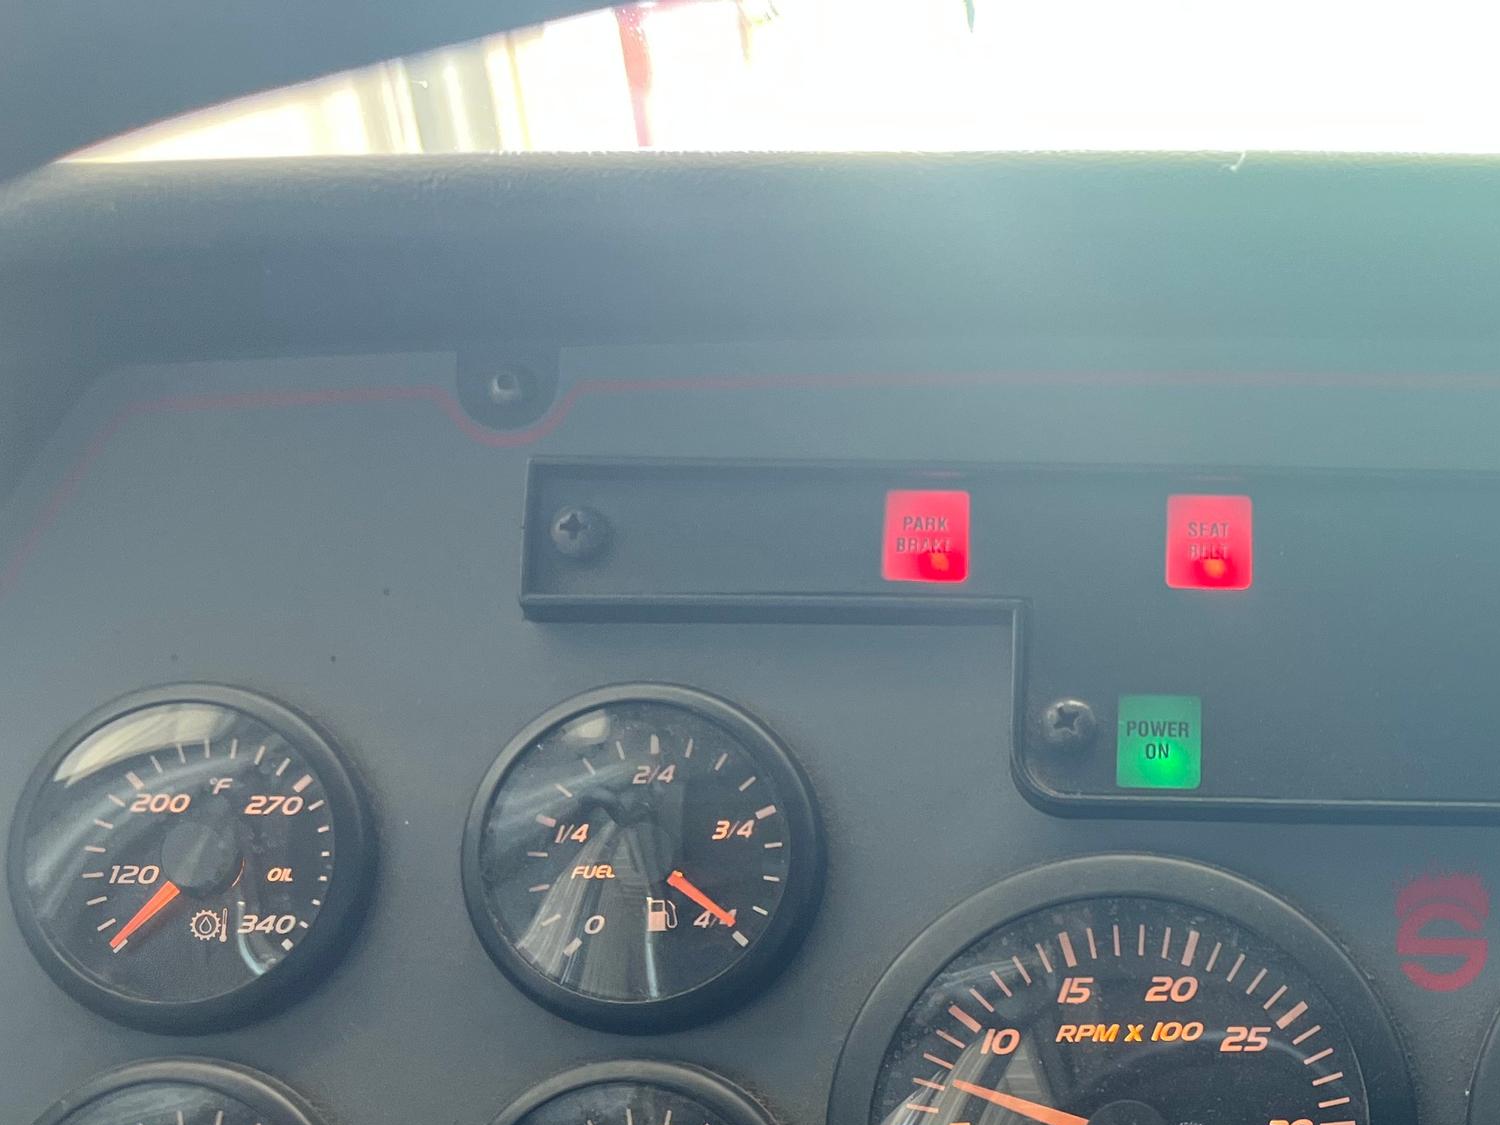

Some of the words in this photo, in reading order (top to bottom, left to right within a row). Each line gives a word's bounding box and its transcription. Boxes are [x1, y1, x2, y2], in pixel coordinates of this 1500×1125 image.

[903, 516, 947, 531] PARK
[1188, 521, 1230, 537] SEAT
[896, 537, 952, 553] BRAKE
[1126, 721, 1190, 738] POWER
[1145, 743, 1170, 760] ON
[632, 764, 676, 784] 2/4
[130, 793, 191, 813] 200
[244, 796, 304, 815] 270
[555, 823, 589, 843] 1/4
[711, 820, 754, 840] 3/4
[108, 865, 160, 884] 120
[267, 868, 293, 882] OIL
[571, 865, 615, 879] FUEL
[237, 914, 296, 934] 340
[584, 915, 605, 934] 0
[1057, 977, 1094, 1004] 15
[1144, 976, 1199, 1003] 20
[980, 1028, 1021, 1054] 10
[1055, 1024, 1119, 1043] RPM
[1151, 1021, 1204, 1042] 100
[1219, 1026, 1271, 1052] 25
